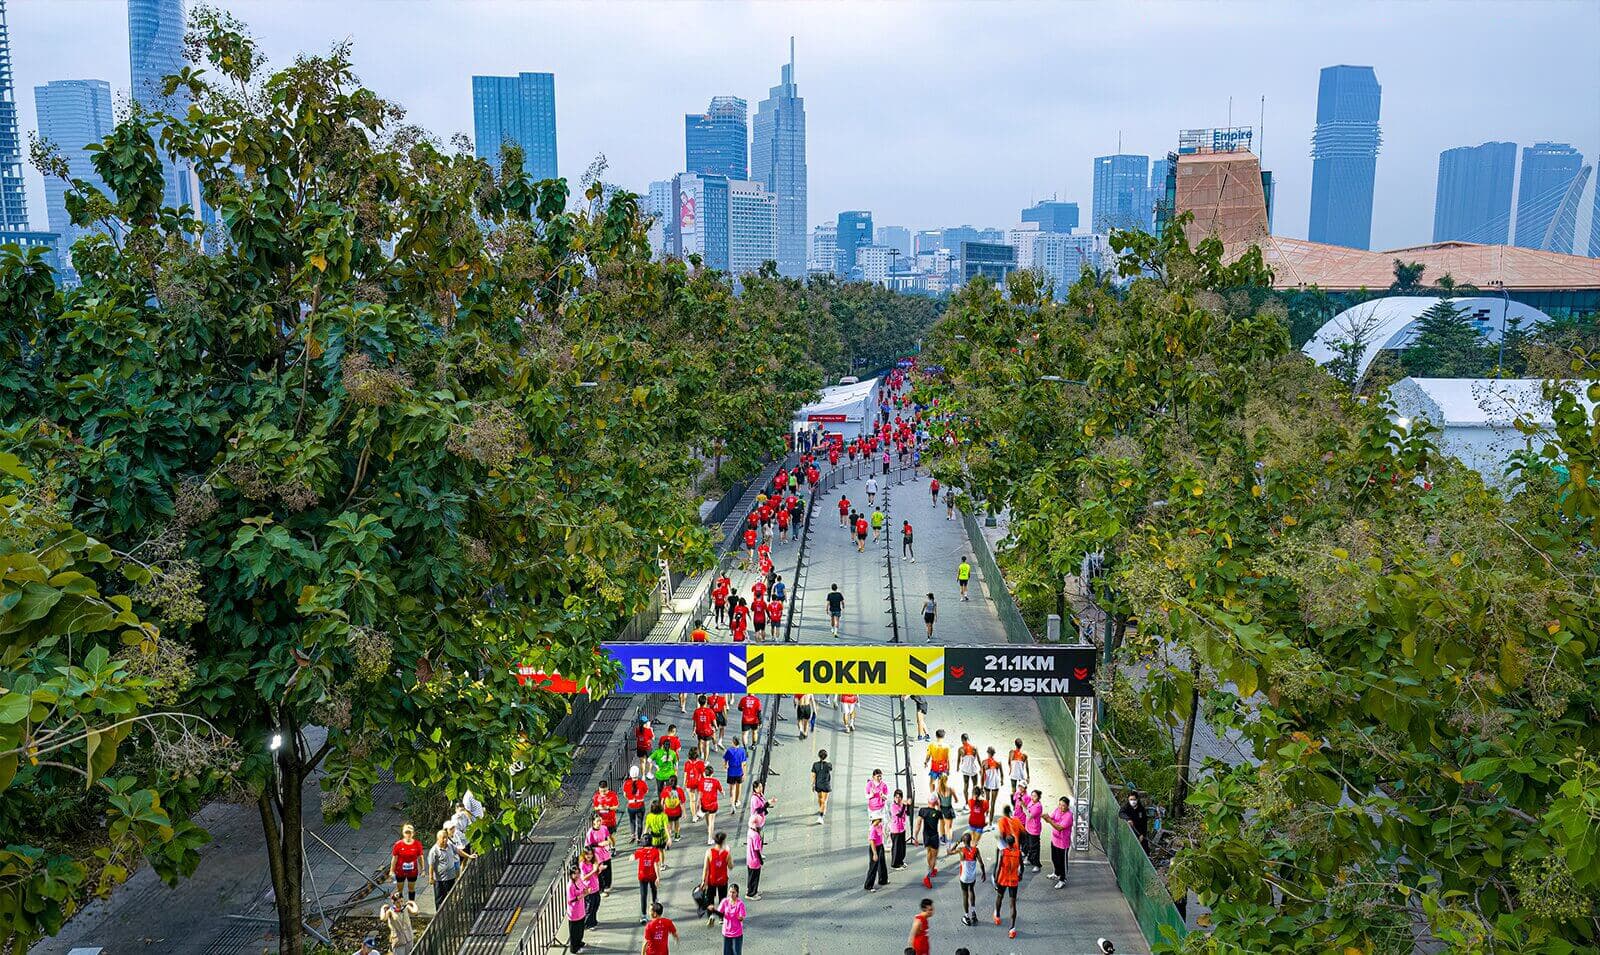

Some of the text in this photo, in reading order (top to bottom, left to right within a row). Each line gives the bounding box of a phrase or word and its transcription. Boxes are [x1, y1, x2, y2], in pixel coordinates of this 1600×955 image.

[1213, 129, 1252, 141] Empire
[1213, 142, 1236, 152] City
[631, 658, 704, 682] 5KM
[984, 655, 1055, 671] 21.1KM
[796, 660, 886, 684] 10KM
[969, 677, 1069, 693] 42.195KM
